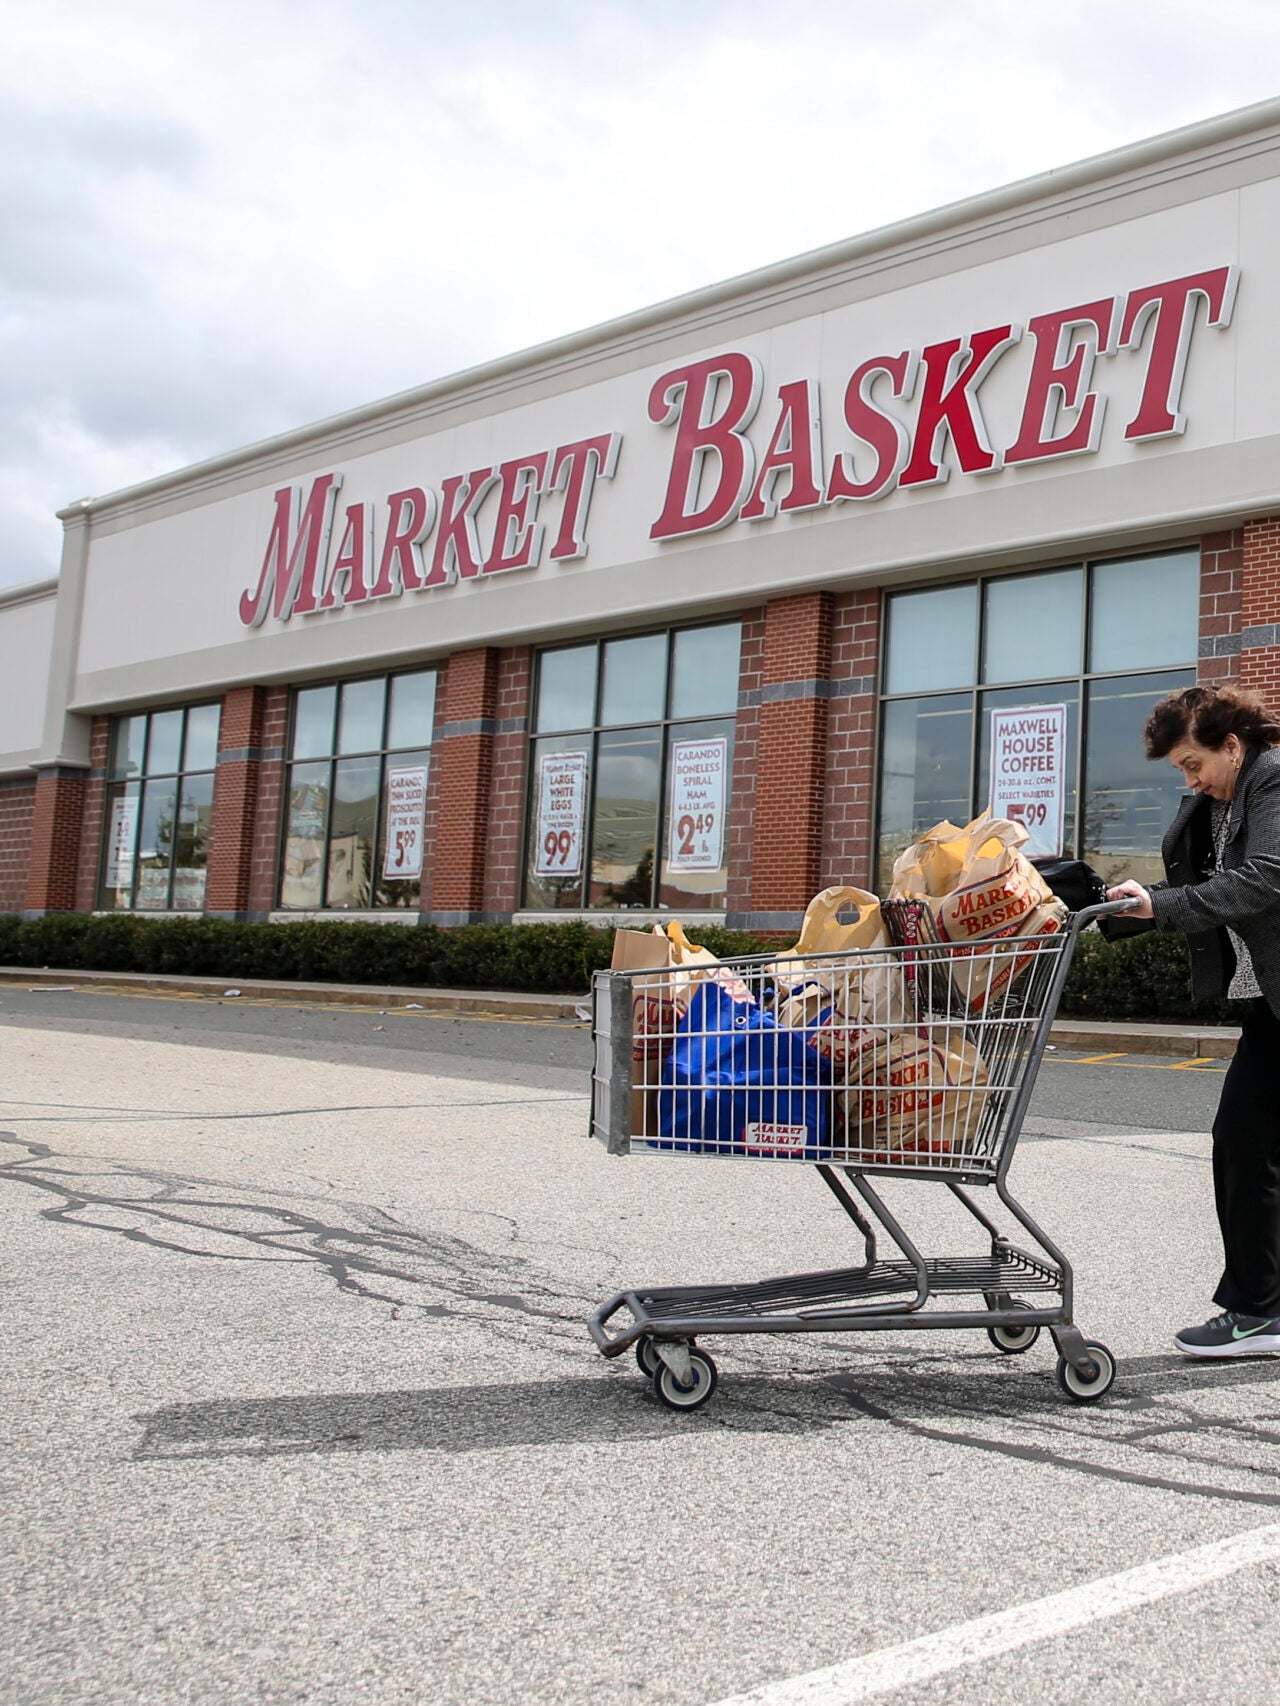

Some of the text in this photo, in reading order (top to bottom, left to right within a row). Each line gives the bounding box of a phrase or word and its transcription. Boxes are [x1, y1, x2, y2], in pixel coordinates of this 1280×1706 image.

[238, 264, 1241, 627] MARKET BASKET
[998, 718, 1058, 737] MAXWELL
[1003, 736, 1054, 755] HOUSE
[676, 748, 721, 762] CARANDO
[676, 762, 720, 775] BONELESS
[1002, 756, 1054, 773] COFFEE
[550, 774, 575, 785] LARGE
[683, 776, 712, 787] SPIRAL
[550, 787, 574, 797] WHITE
[687, 790, 707, 799] HAM
[998, 790, 1020, 800] SELECT
[551, 800, 572, 810] EGGS
[951, 878, 1021, 918] MARK
[754, 1133, 800, 1145] BAKET
